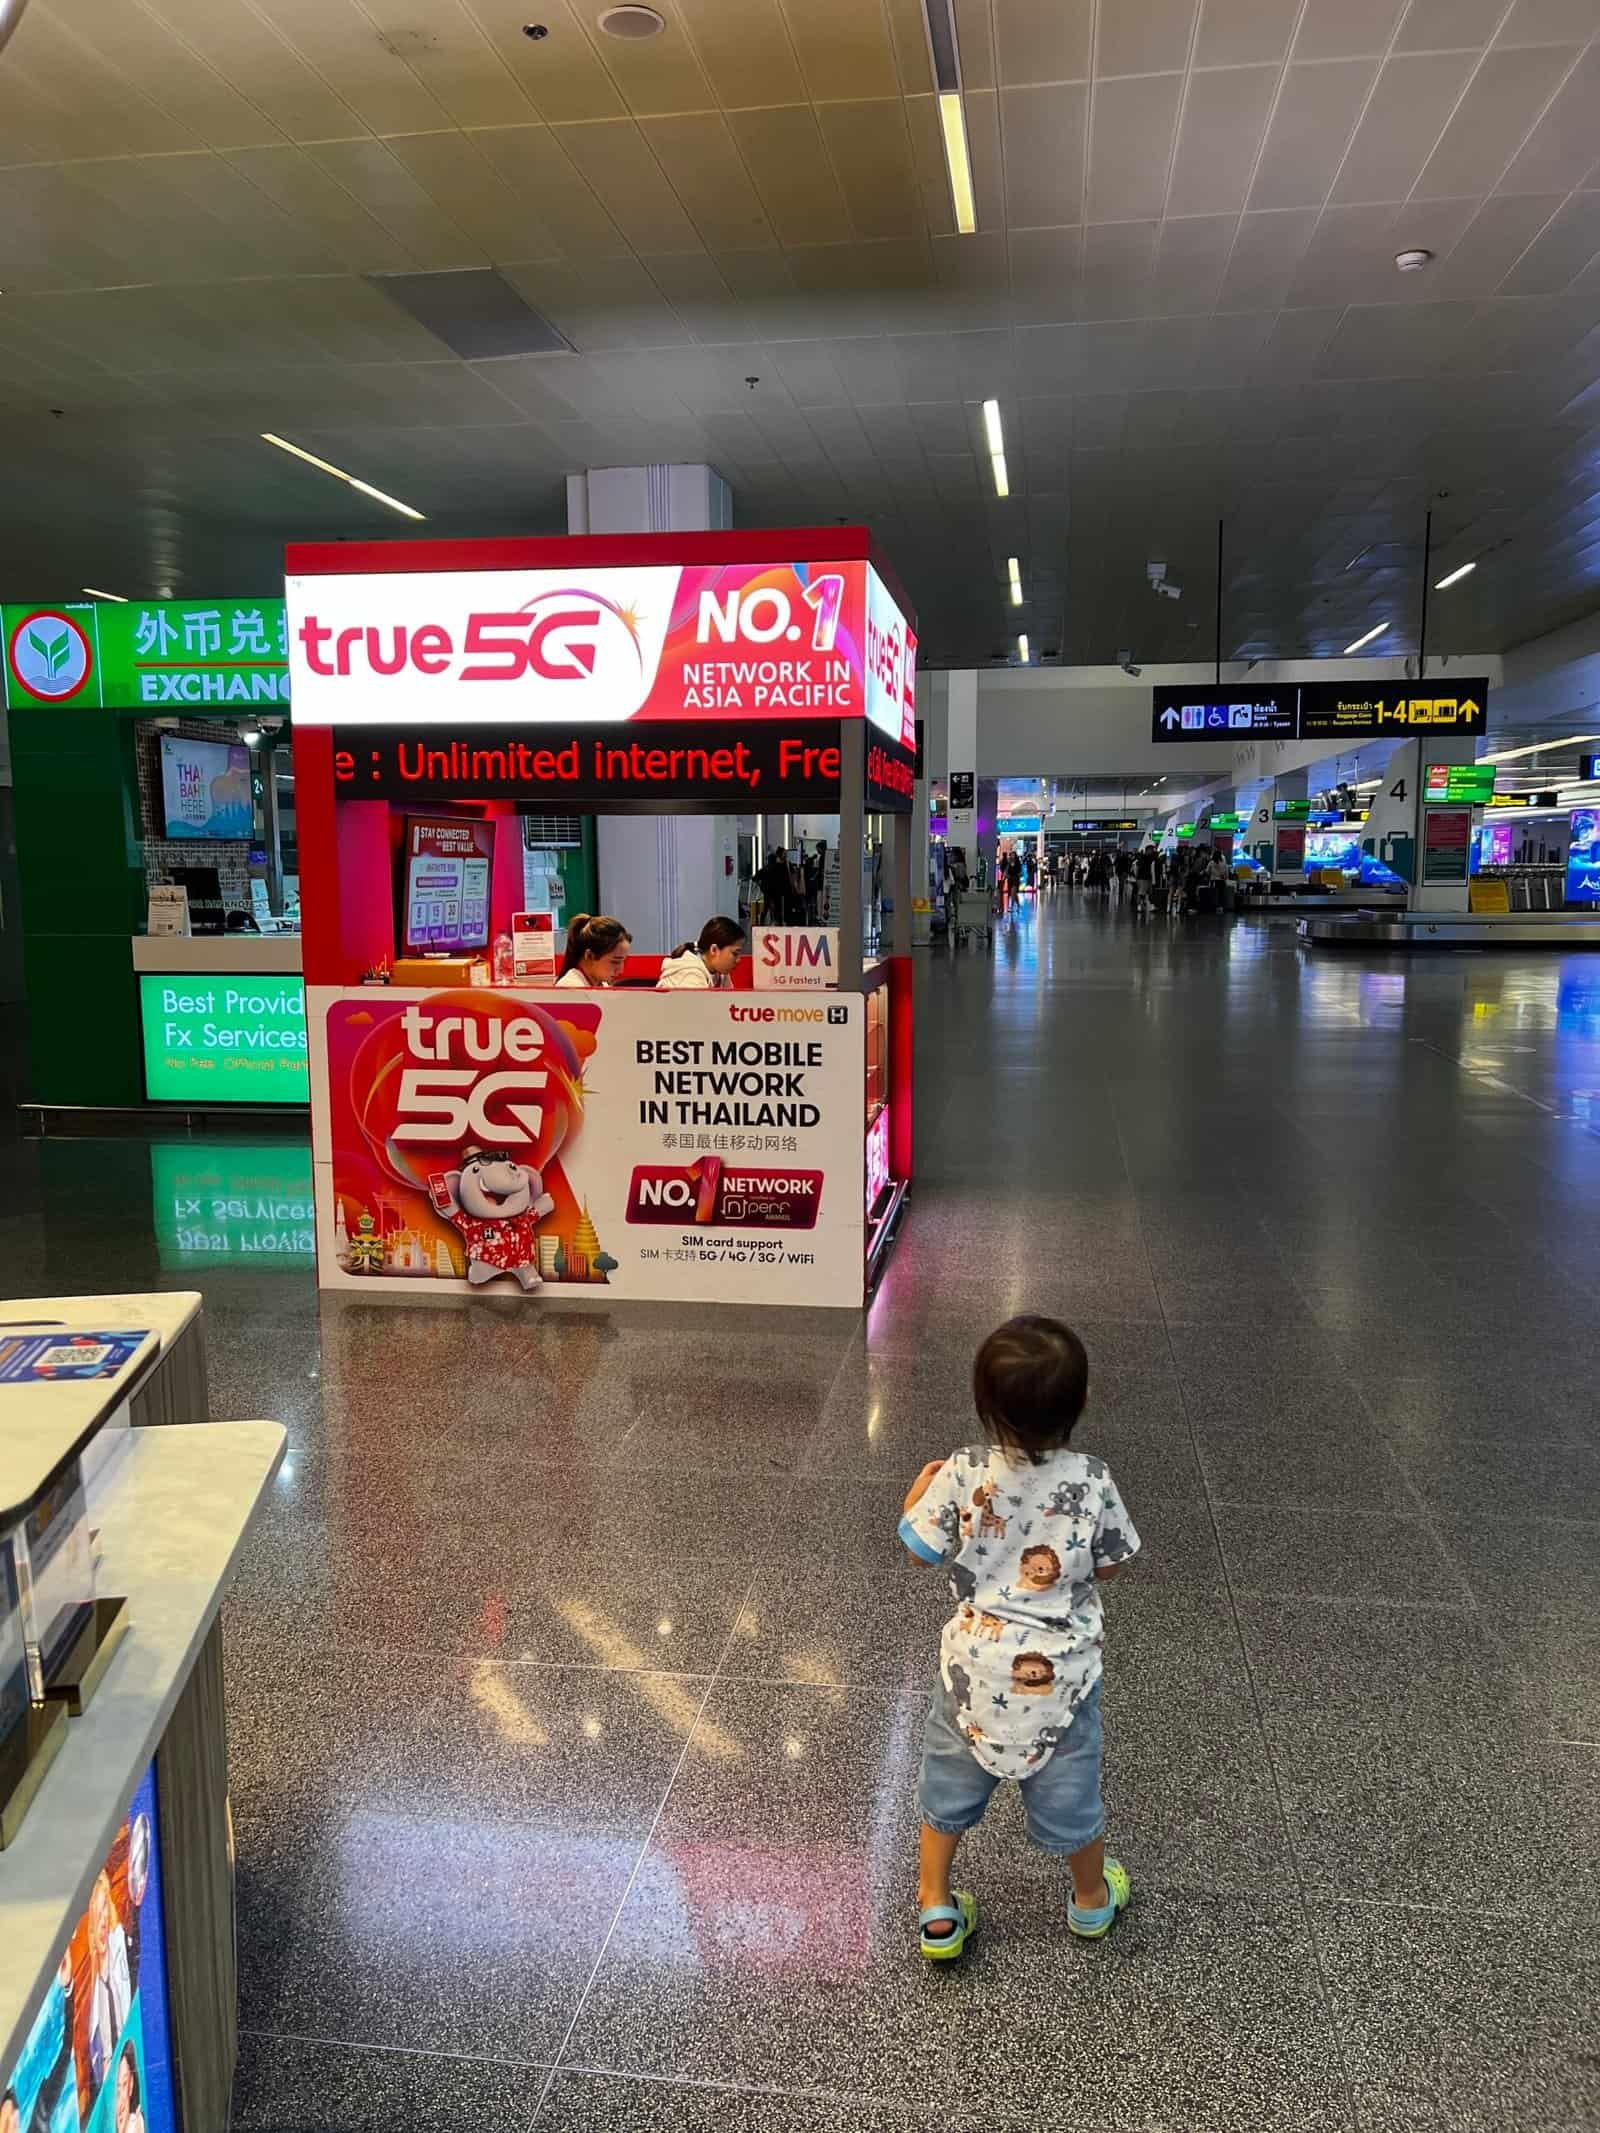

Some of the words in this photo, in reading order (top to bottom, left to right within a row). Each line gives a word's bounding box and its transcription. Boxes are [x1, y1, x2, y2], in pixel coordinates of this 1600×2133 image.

[696, 574, 844, 651] NO.1
[299, 616, 453, 675] true
[459, 611, 601, 680] 5G
[684, 662, 811, 685] NETWORK
[826, 660, 850, 682] IN
[684, 686, 742, 708] ASIA
[755, 684, 850, 707] PACIFIC
[1374, 700, 1407, 724] 1-4
[398, 741, 579, 780] Unlimited
[595, 742, 761, 788] internet,
[779, 739, 840, 779] Fre
[1390, 779, 1407, 802] 4
[1259, 809, 1269, 823] 3
[761, 934, 832, 967] SIM
[789, 976, 821, 986] Fastest
[163, 989, 215, 1014] Best
[226, 988, 304, 1014] Provid
[165, 1023, 192, 1047] Fx
[203, 1022, 308, 1048] Services
[401, 1006, 545, 1062] true
[636, 1040, 704, 1064] BEST
[712, 1041, 822, 1067] MOBILE
[655, 1071, 805, 1097] NETWORK
[391, 1069, 548, 1142] 5G
[640, 1101, 668, 1124] IN
[675, 1102, 820, 1127] THAILAND
[663, 1133, 799, 1152] 泰国最佳移动网络
[638, 1156, 721, 1222] NO.1
[723, 1177, 814, 1195] NETWORK
[682, 1236, 704, 1247] SIM
[706, 1236, 733, 1248] card
[736, 1239, 783, 1251] support
[640, 1249, 659, 1260] SIM
[663, 1250, 696, 1262] 卡支持
[699, 1250, 716, 1261] 5G
[728, 1252, 747, 1262] 4G
[758, 1252, 776, 1263] 3G
[788, 1252, 814, 1265] WiFi
